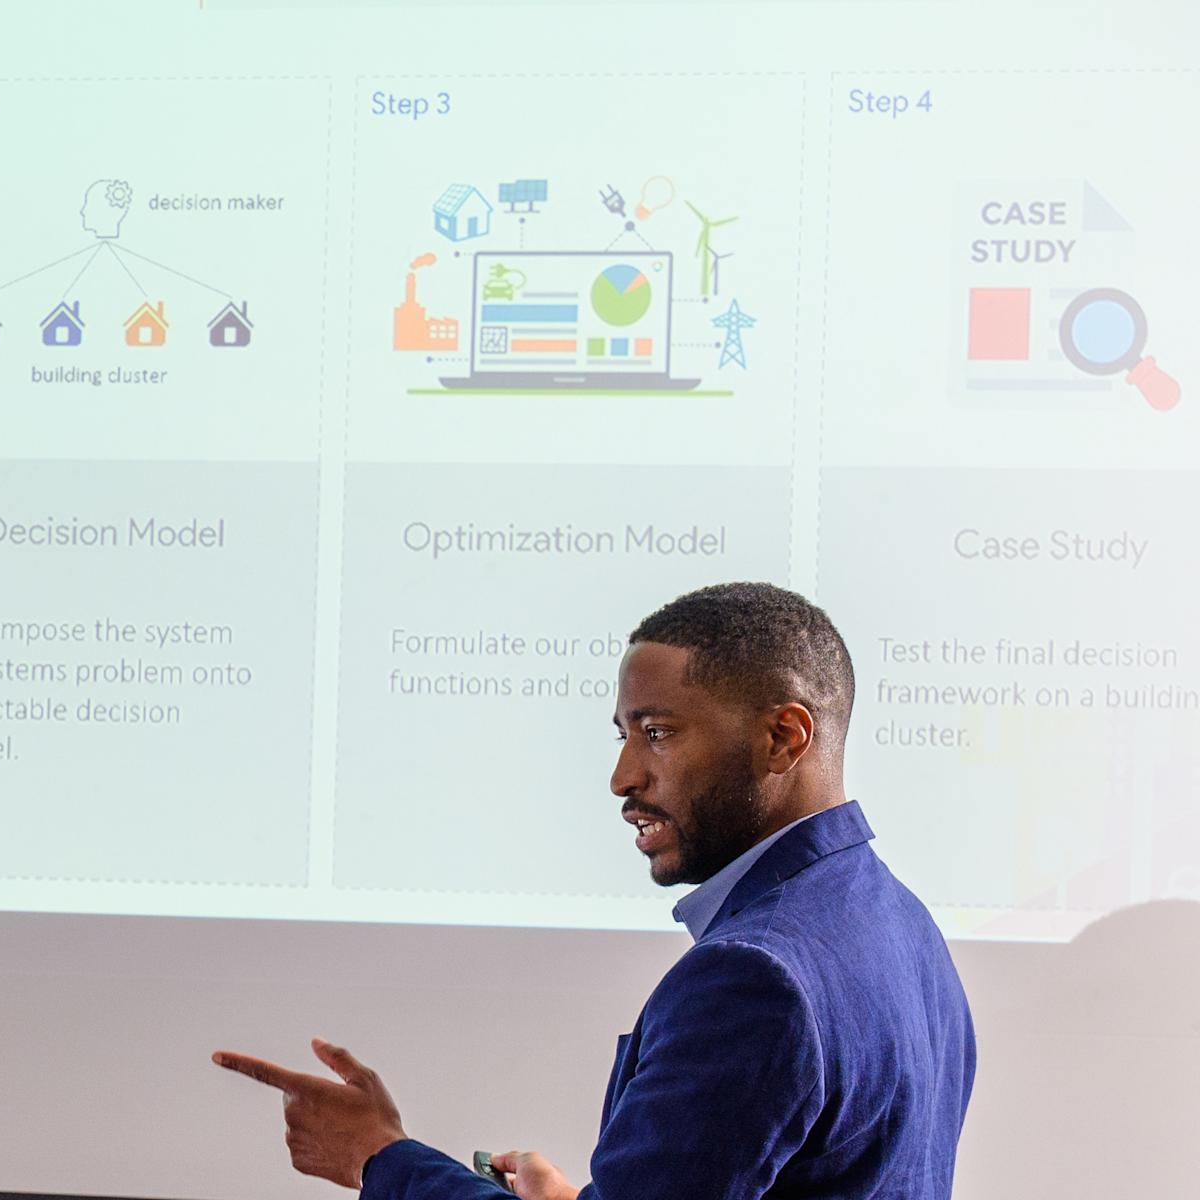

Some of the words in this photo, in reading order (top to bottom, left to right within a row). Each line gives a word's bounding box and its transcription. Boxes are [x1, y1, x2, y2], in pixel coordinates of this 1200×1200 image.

[371, 91, 429, 120] Step
[435, 93, 451, 115] 3
[847, 88, 910, 119] Step
[916, 89, 934, 113] 4
[148, 192, 222, 211] decision
[227, 193, 284, 211] maker
[980, 201, 1068, 227] CASE
[970, 239, 1077, 264] STUDY
[31, 366, 102, 386] building
[107, 366, 168, 385] cluster
[128, 518, 225, 549] Model
[402, 521, 615, 561] Optimization
[625, 524, 726, 556] Model
[953, 528, 1041, 560] Case
[1050, 530, 1150, 570] Study
[94, 618, 136, 644] the
[144, 621, 233, 649] system
[391, 629, 526, 657] Formulate
[534, 635, 581, 658] our
[878, 637, 932, 664] Test
[941, 638, 986, 665] the
[995, 638, 1054, 667] final
[1063, 639, 1178, 669] decision
[76, 659, 183, 689] problem
[192, 663, 253, 687] onto
[389, 670, 513, 696] functions
[521, 674, 570, 699] and
[875, 678, 1026, 707] framework
[1034, 688, 1070, 708] on
[1079, 689, 1095, 709] a
[1106, 683, 1199, 708] buildin
[76, 699, 181, 724] decision
[874, 720, 971, 748] cluster.
